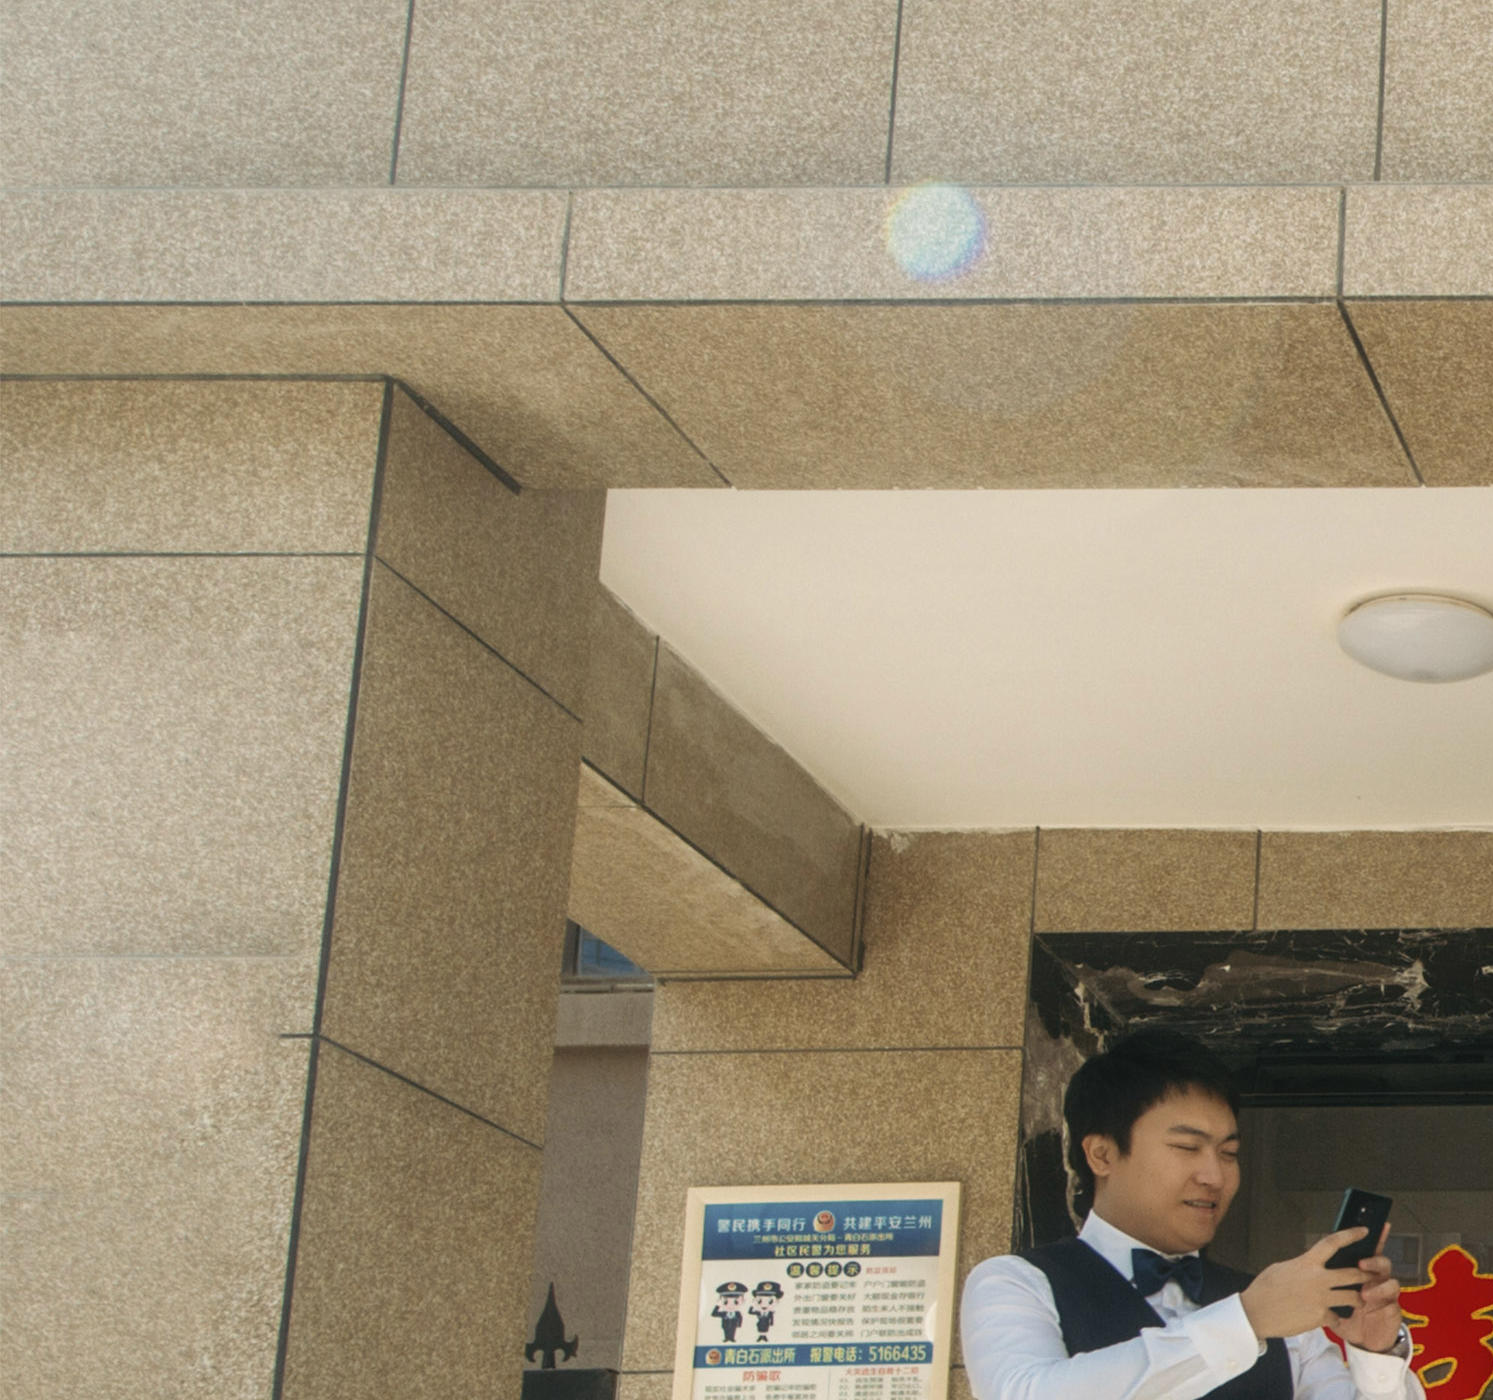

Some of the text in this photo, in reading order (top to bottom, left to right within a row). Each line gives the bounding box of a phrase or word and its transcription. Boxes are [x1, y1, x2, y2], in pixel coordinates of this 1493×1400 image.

[717, 1215, 932, 1233] 警民携手同行 共建平安兰州
[774, 1244, 871, 1257] 社区民警为您服务
[725, 1348, 796, 1365] 青白石派出所
